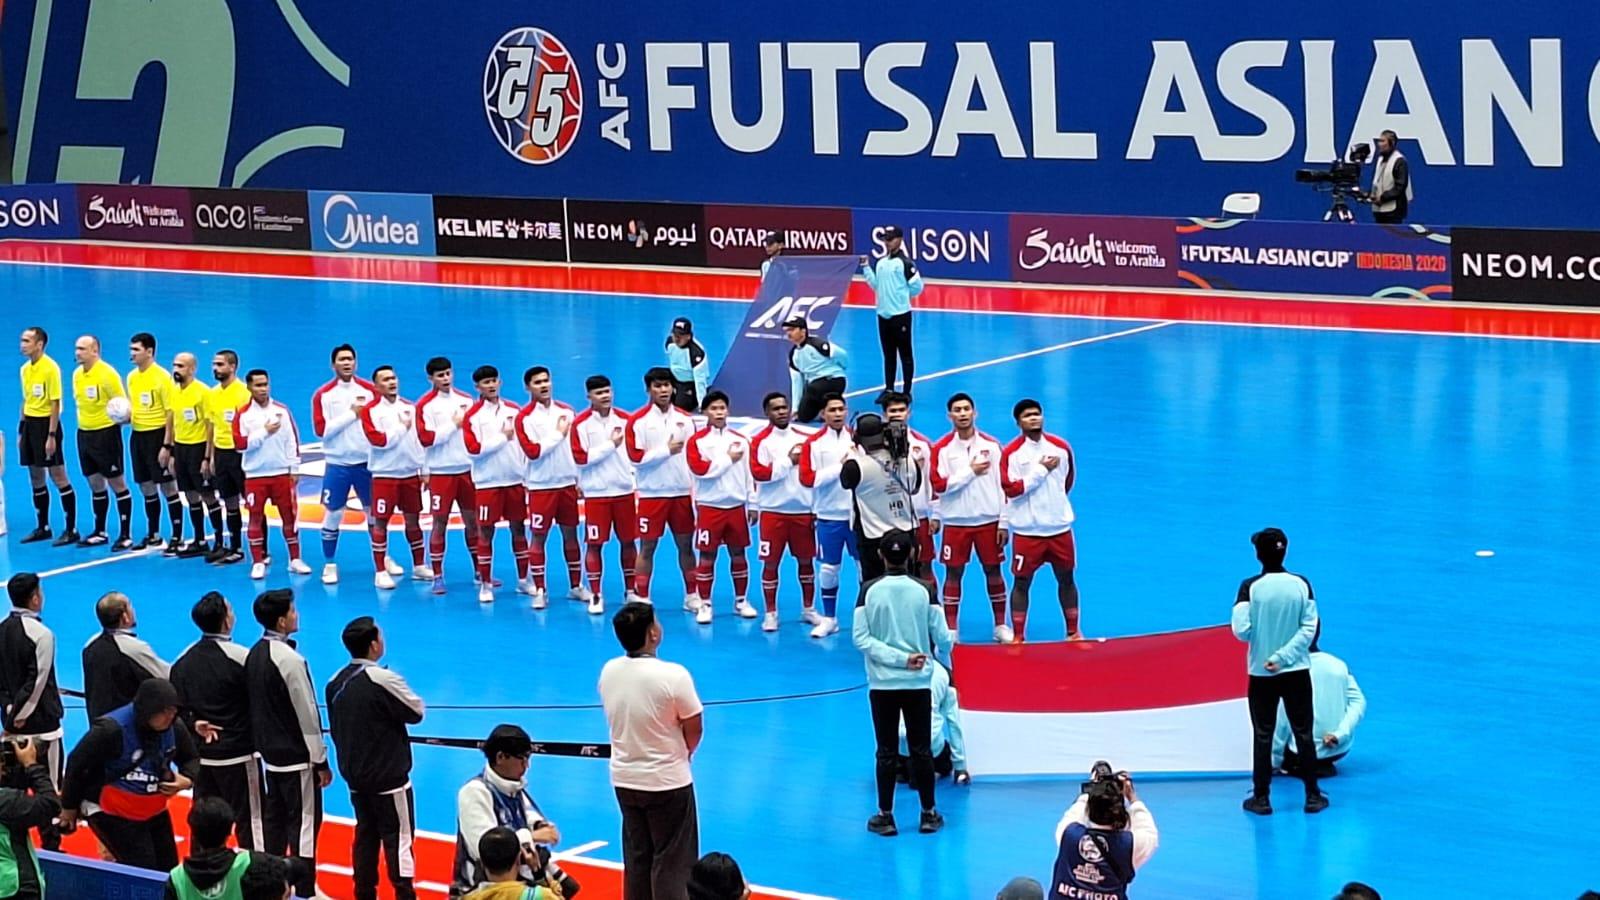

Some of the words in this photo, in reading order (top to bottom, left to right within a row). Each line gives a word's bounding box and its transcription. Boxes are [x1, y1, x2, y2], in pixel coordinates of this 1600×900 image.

[596, 42, 631, 151] AFC
[644, 41, 1098, 160] FUTSAL
[1125, 38, 1563, 168] ASIAN
[196, 203, 247, 229] ace
[338, 212, 419, 245] Midea
[437, 217, 505, 238] KELME
[573, 222, 623, 241] NEOM
[774, 229, 848, 251] IRWAYS
[1019, 228, 1105, 270] Saudi
[1105, 240, 1157, 255] Welcome
[1115, 254, 1128, 266] to
[1129, 254, 1166, 268] Arabia
[1189, 244, 1254, 264] FUTSAL
[1356, 252, 1413, 271] INDONESIA
[749, 296, 837, 329] AFC
[323, 489, 330, 504] 2
[431, 495, 442, 510] 3
[376, 499, 387, 514] 6
[639, 517, 650, 533] 5
[943, 545, 952, 561] 9
[1013, 554, 1025, 571] 7
